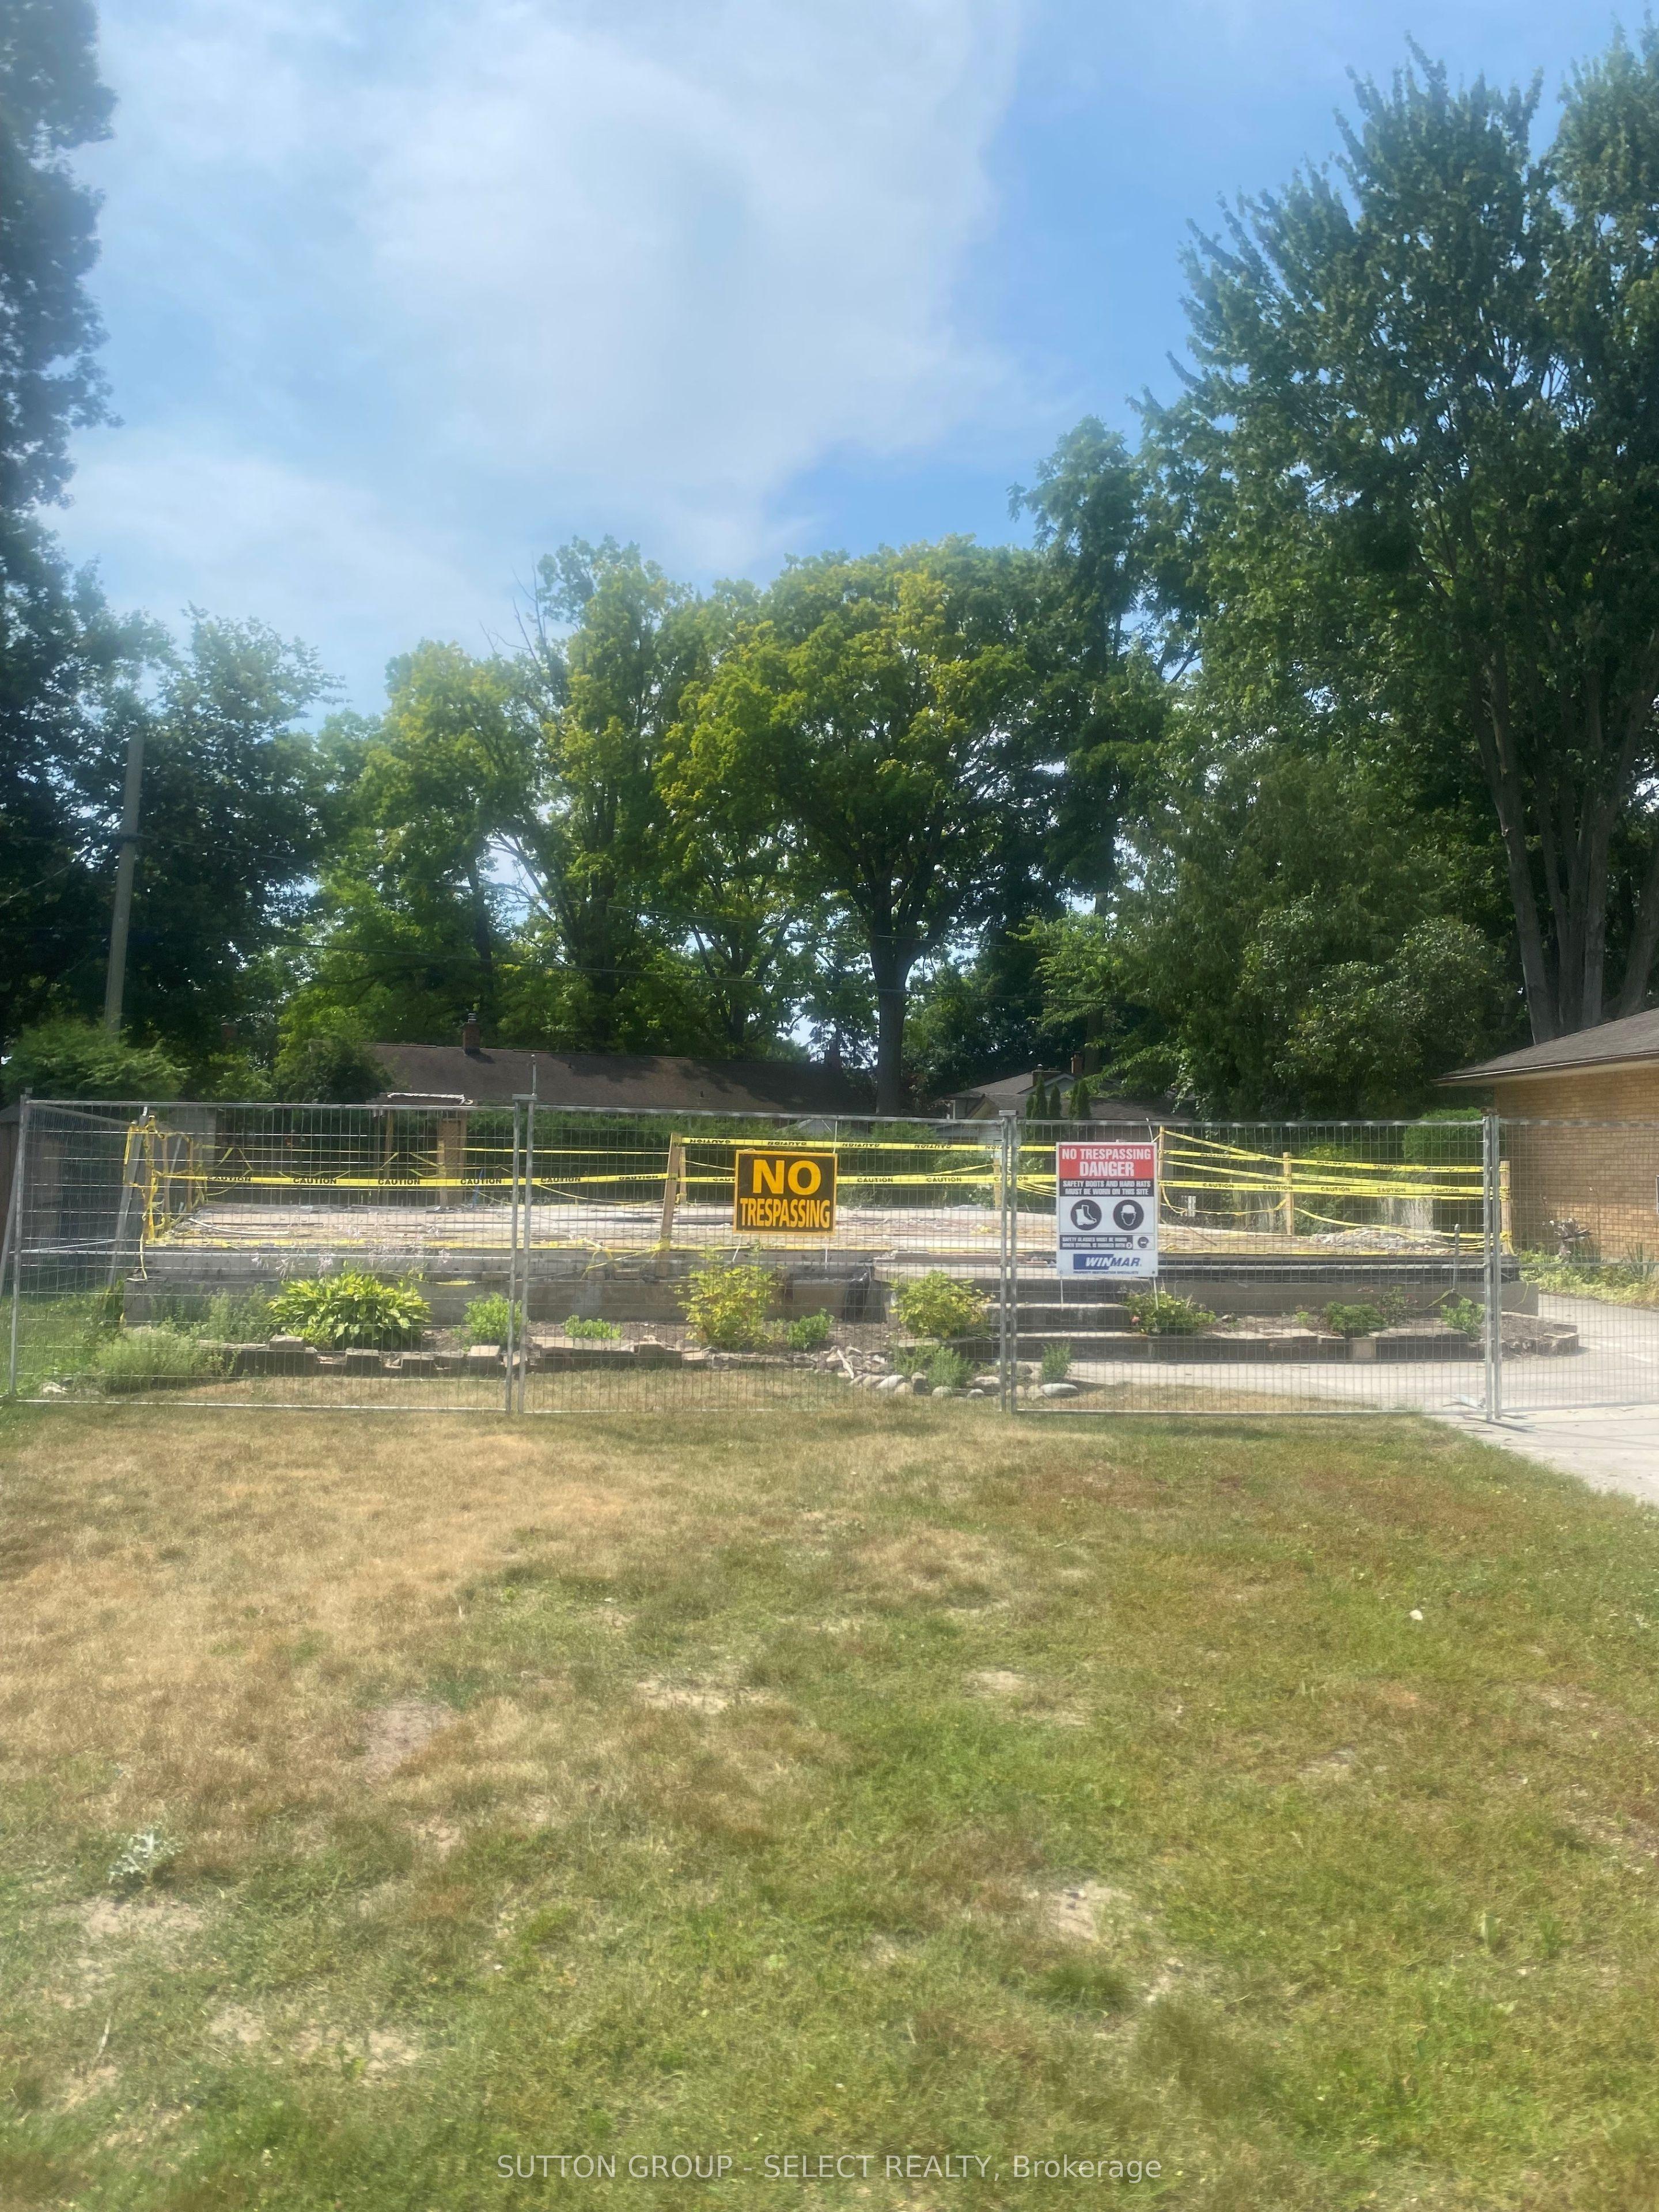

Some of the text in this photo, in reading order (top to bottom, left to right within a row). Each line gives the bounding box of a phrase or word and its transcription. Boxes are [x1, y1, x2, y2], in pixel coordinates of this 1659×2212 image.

[1062, 1148, 1152, 1160] NO TRESPASSING
[752, 1159, 821, 1195] NO
[1079, 1161, 1135, 1177] DANGER
[740, 1198, 830, 1228] TRESPASSING
[1085, 1257, 1141, 1267] WINMAR
